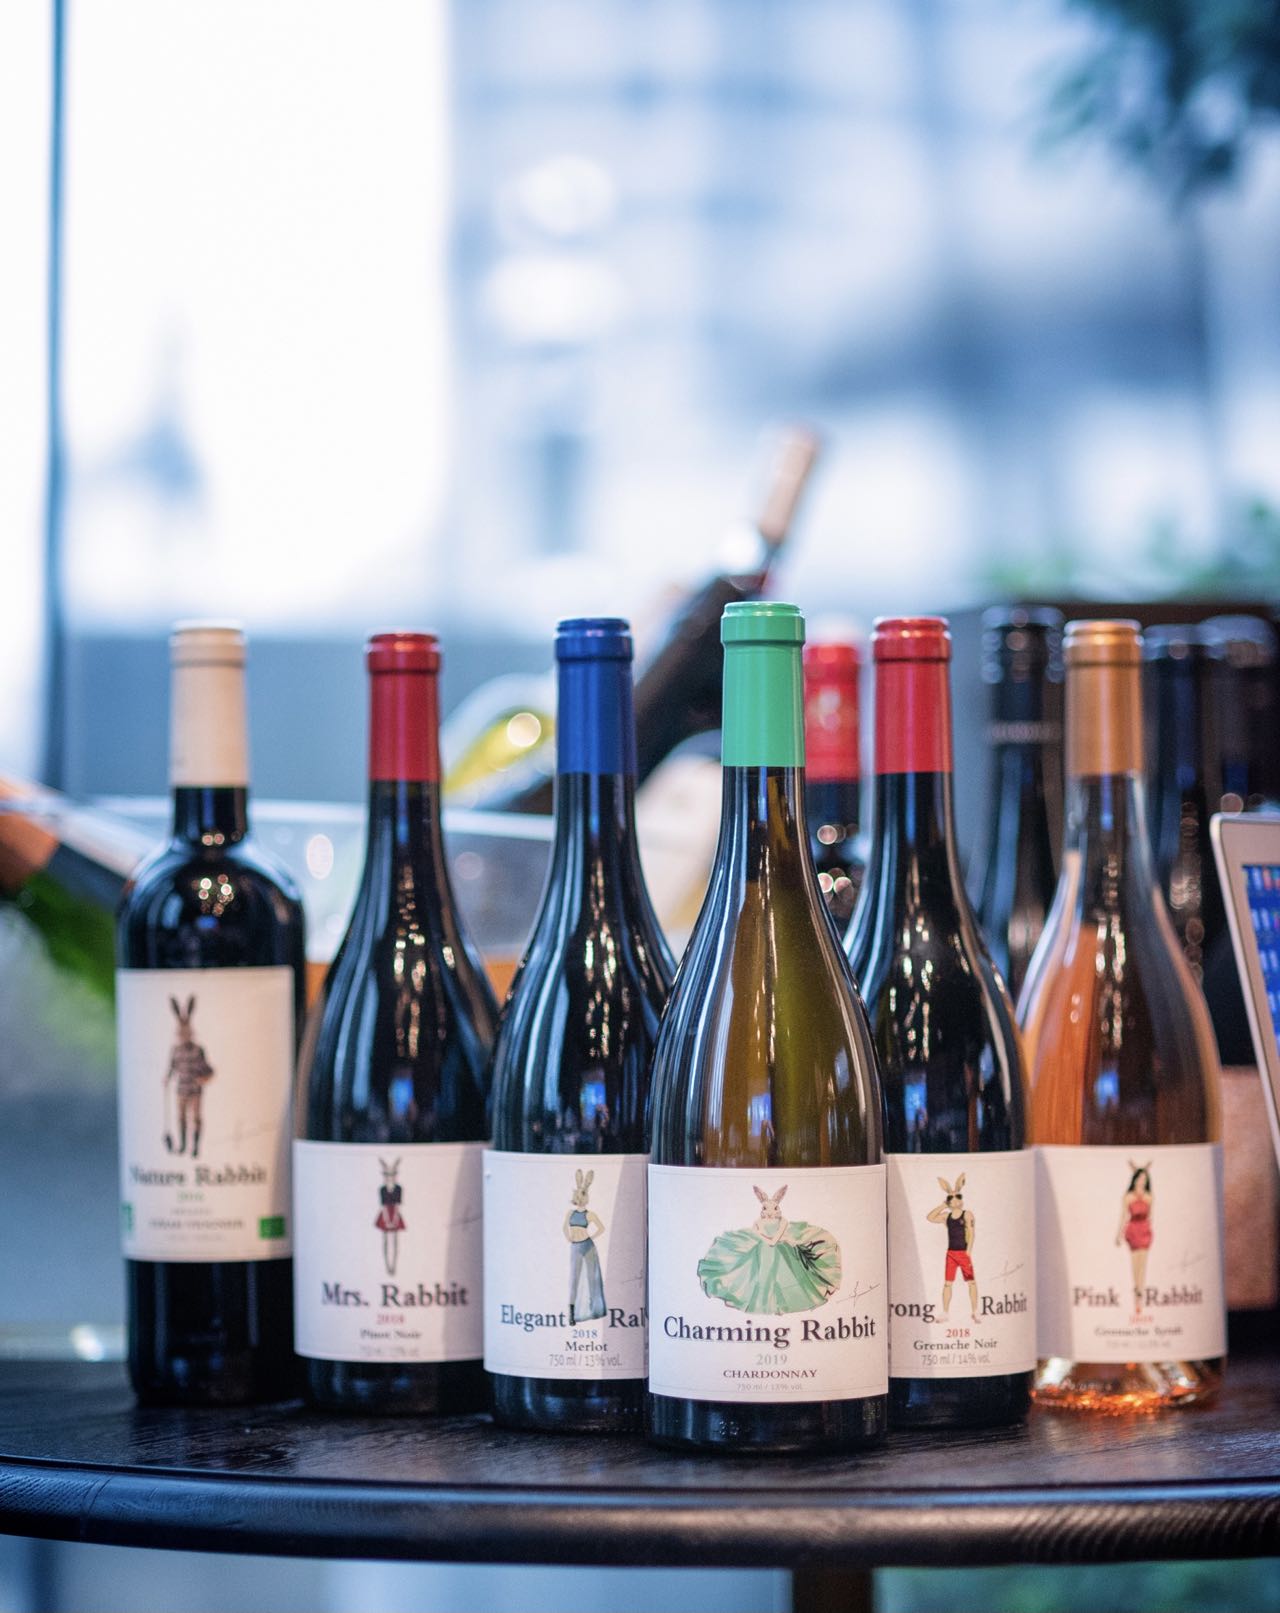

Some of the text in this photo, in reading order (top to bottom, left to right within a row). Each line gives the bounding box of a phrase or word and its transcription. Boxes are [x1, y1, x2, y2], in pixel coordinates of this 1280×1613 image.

[195, 1163, 267, 1185] Rabbit
[322, 1282, 468, 1307] Mrs. Rabbit
[1073, 1283, 1203, 1307] Pink Rabbit
[887, 1292, 1027, 1324] rong Rabbit
[501, 1304, 566, 1332] Elegant
[572, 1329, 598, 1339] 2018
[663, 1315, 876, 1348] Charming Rabbit
[946, 1328, 971, 1338] 2018
[565, 1340, 608, 1352] Merlot
[913, 1338, 997, 1351] Grenache Noir
[755, 1353, 788, 1366] 2019
[722, 1369, 817, 1379] CHARDONNAY
